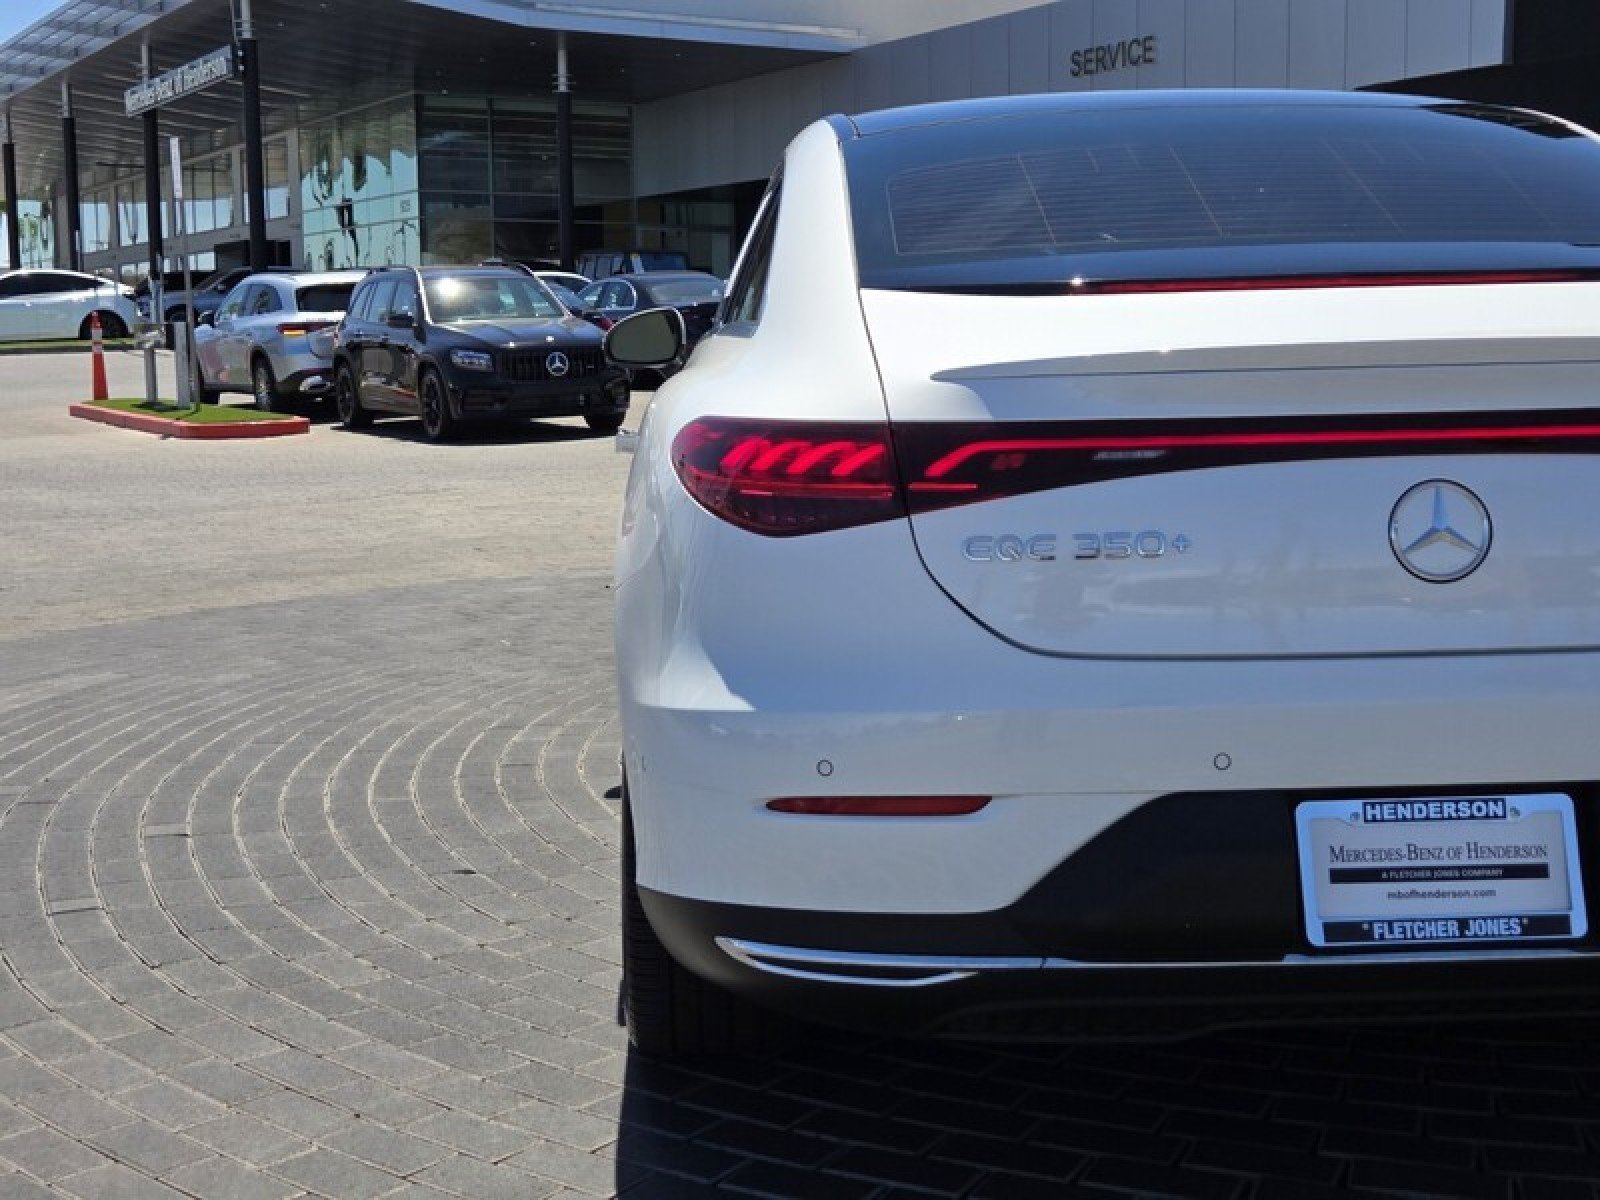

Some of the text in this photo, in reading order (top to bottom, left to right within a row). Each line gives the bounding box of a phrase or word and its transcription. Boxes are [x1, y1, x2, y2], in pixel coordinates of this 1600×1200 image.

[1070, 35, 1155, 77] SERVICE
[963, 530, 1193, 561] EQE 350+
[1365, 800, 1505, 821] HENDERSON
[1466, 842, 1548, 860] HENDERSON
[1389, 869, 1431, 879] FLETCHER
[1433, 869, 1460, 878] JONES
[1461, 868, 1503, 878] COMPANY
[1387, 888, 1497, 900] mbofhenderson.com
[1373, 917, 1522, 939] FLETCHER JONES
